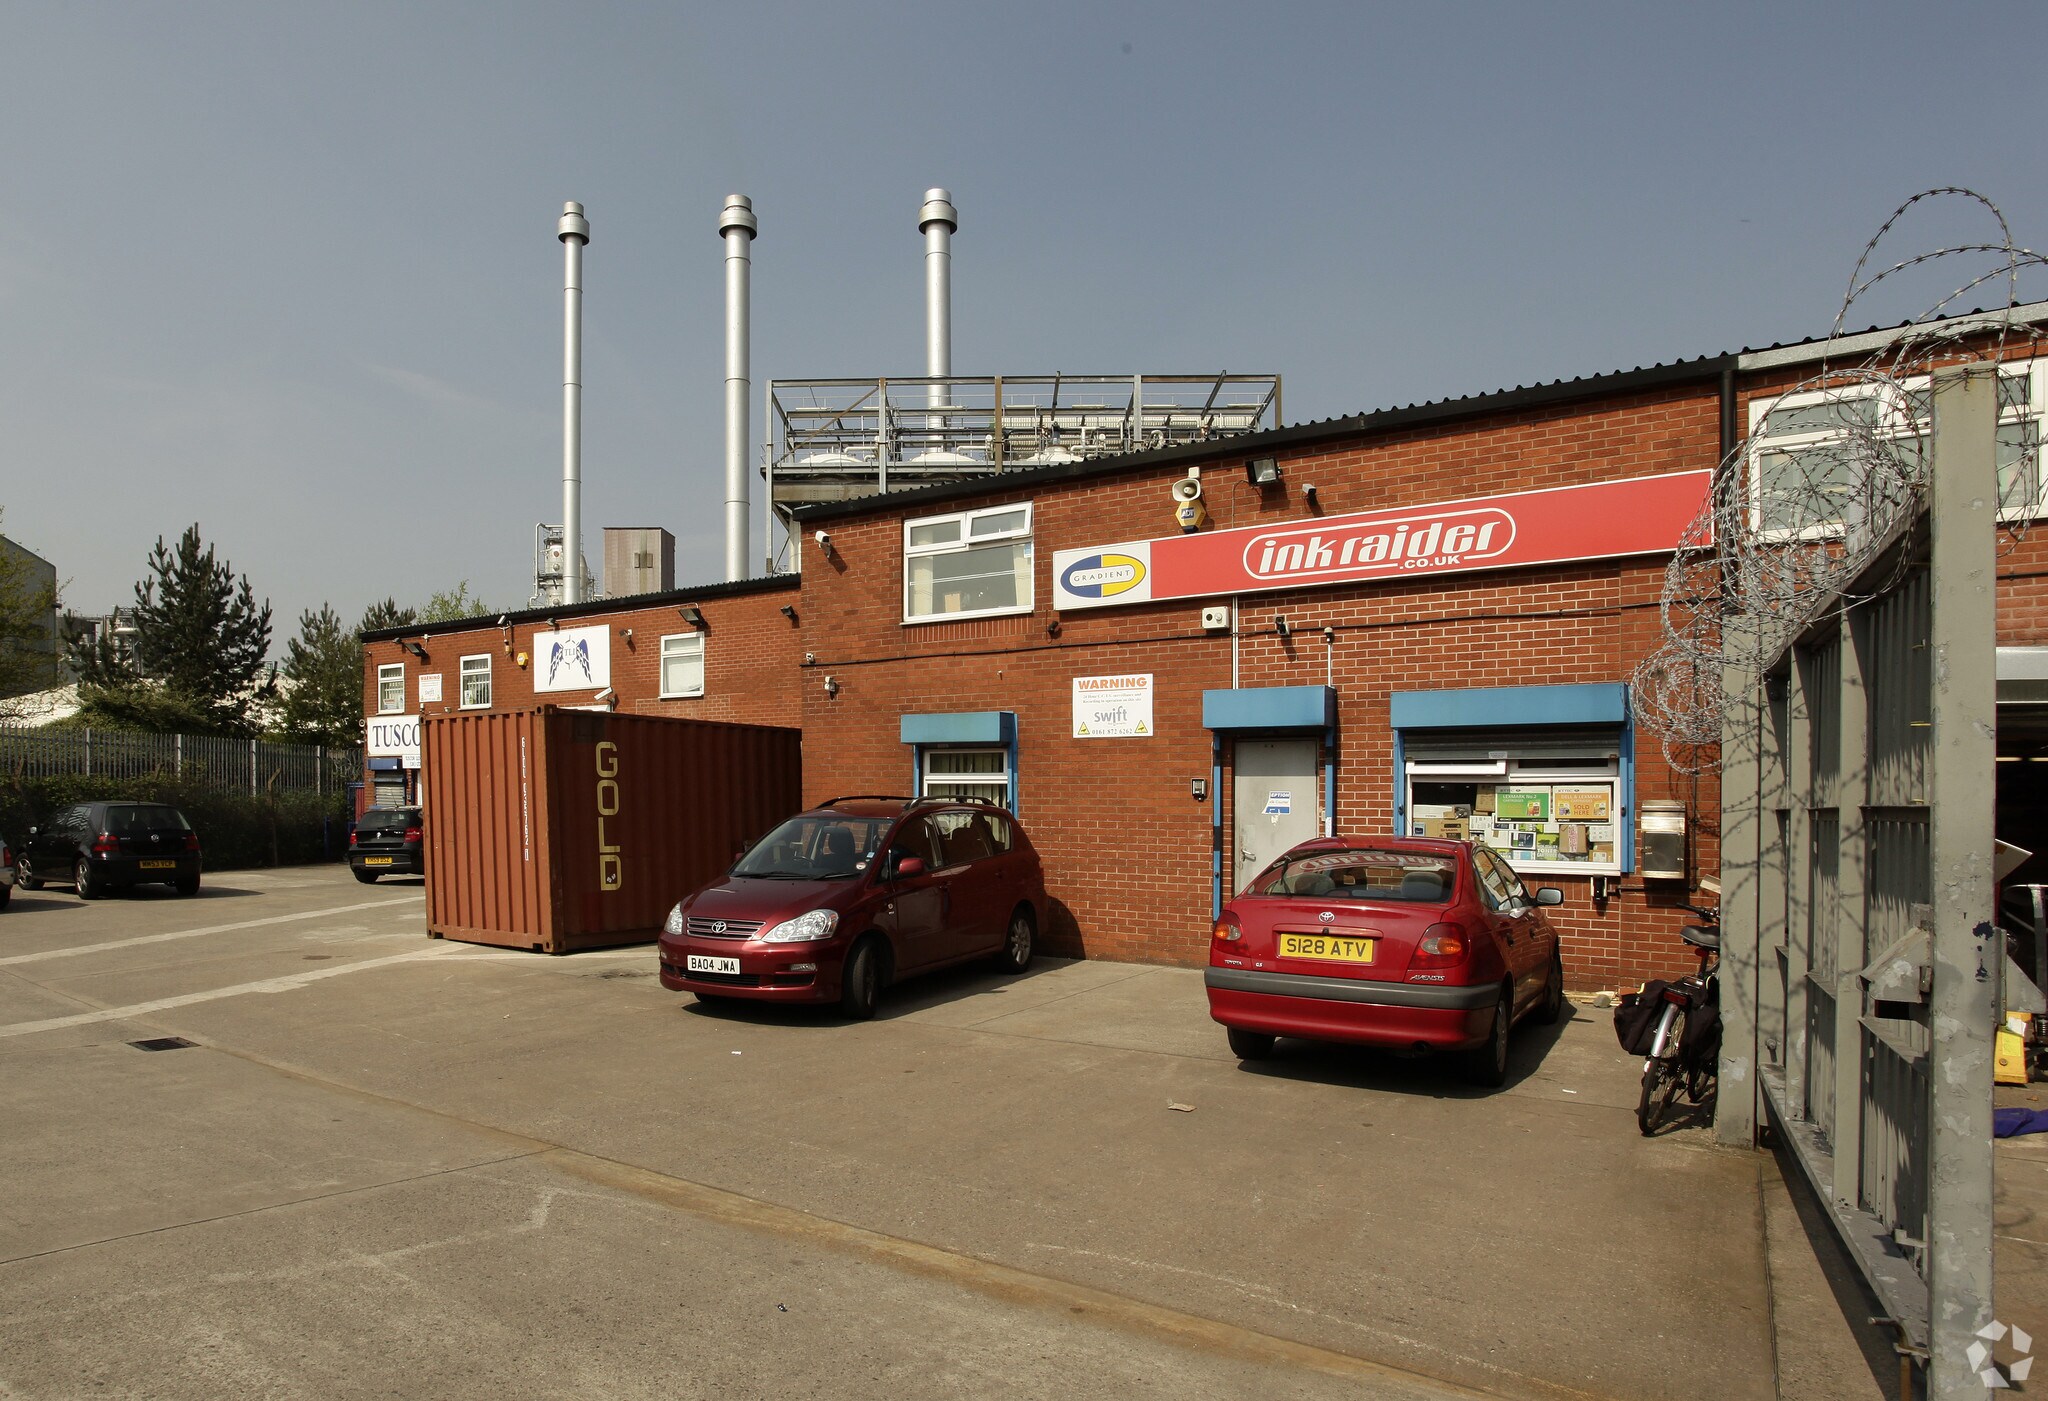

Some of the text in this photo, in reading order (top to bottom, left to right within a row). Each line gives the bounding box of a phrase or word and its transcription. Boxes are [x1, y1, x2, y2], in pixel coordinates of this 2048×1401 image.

[1399, 554, 1461, 570] .CO.UK
[1073, 569, 1131, 582] GRADIENT
[1078, 677, 1147, 689] WARNING
[1094, 705, 1127, 723] swift
[596, 741, 622, 891] GOLD
[1286, 938, 1367, 957] S128 ATV
[691, 957, 735, 972] BA04 JWA
